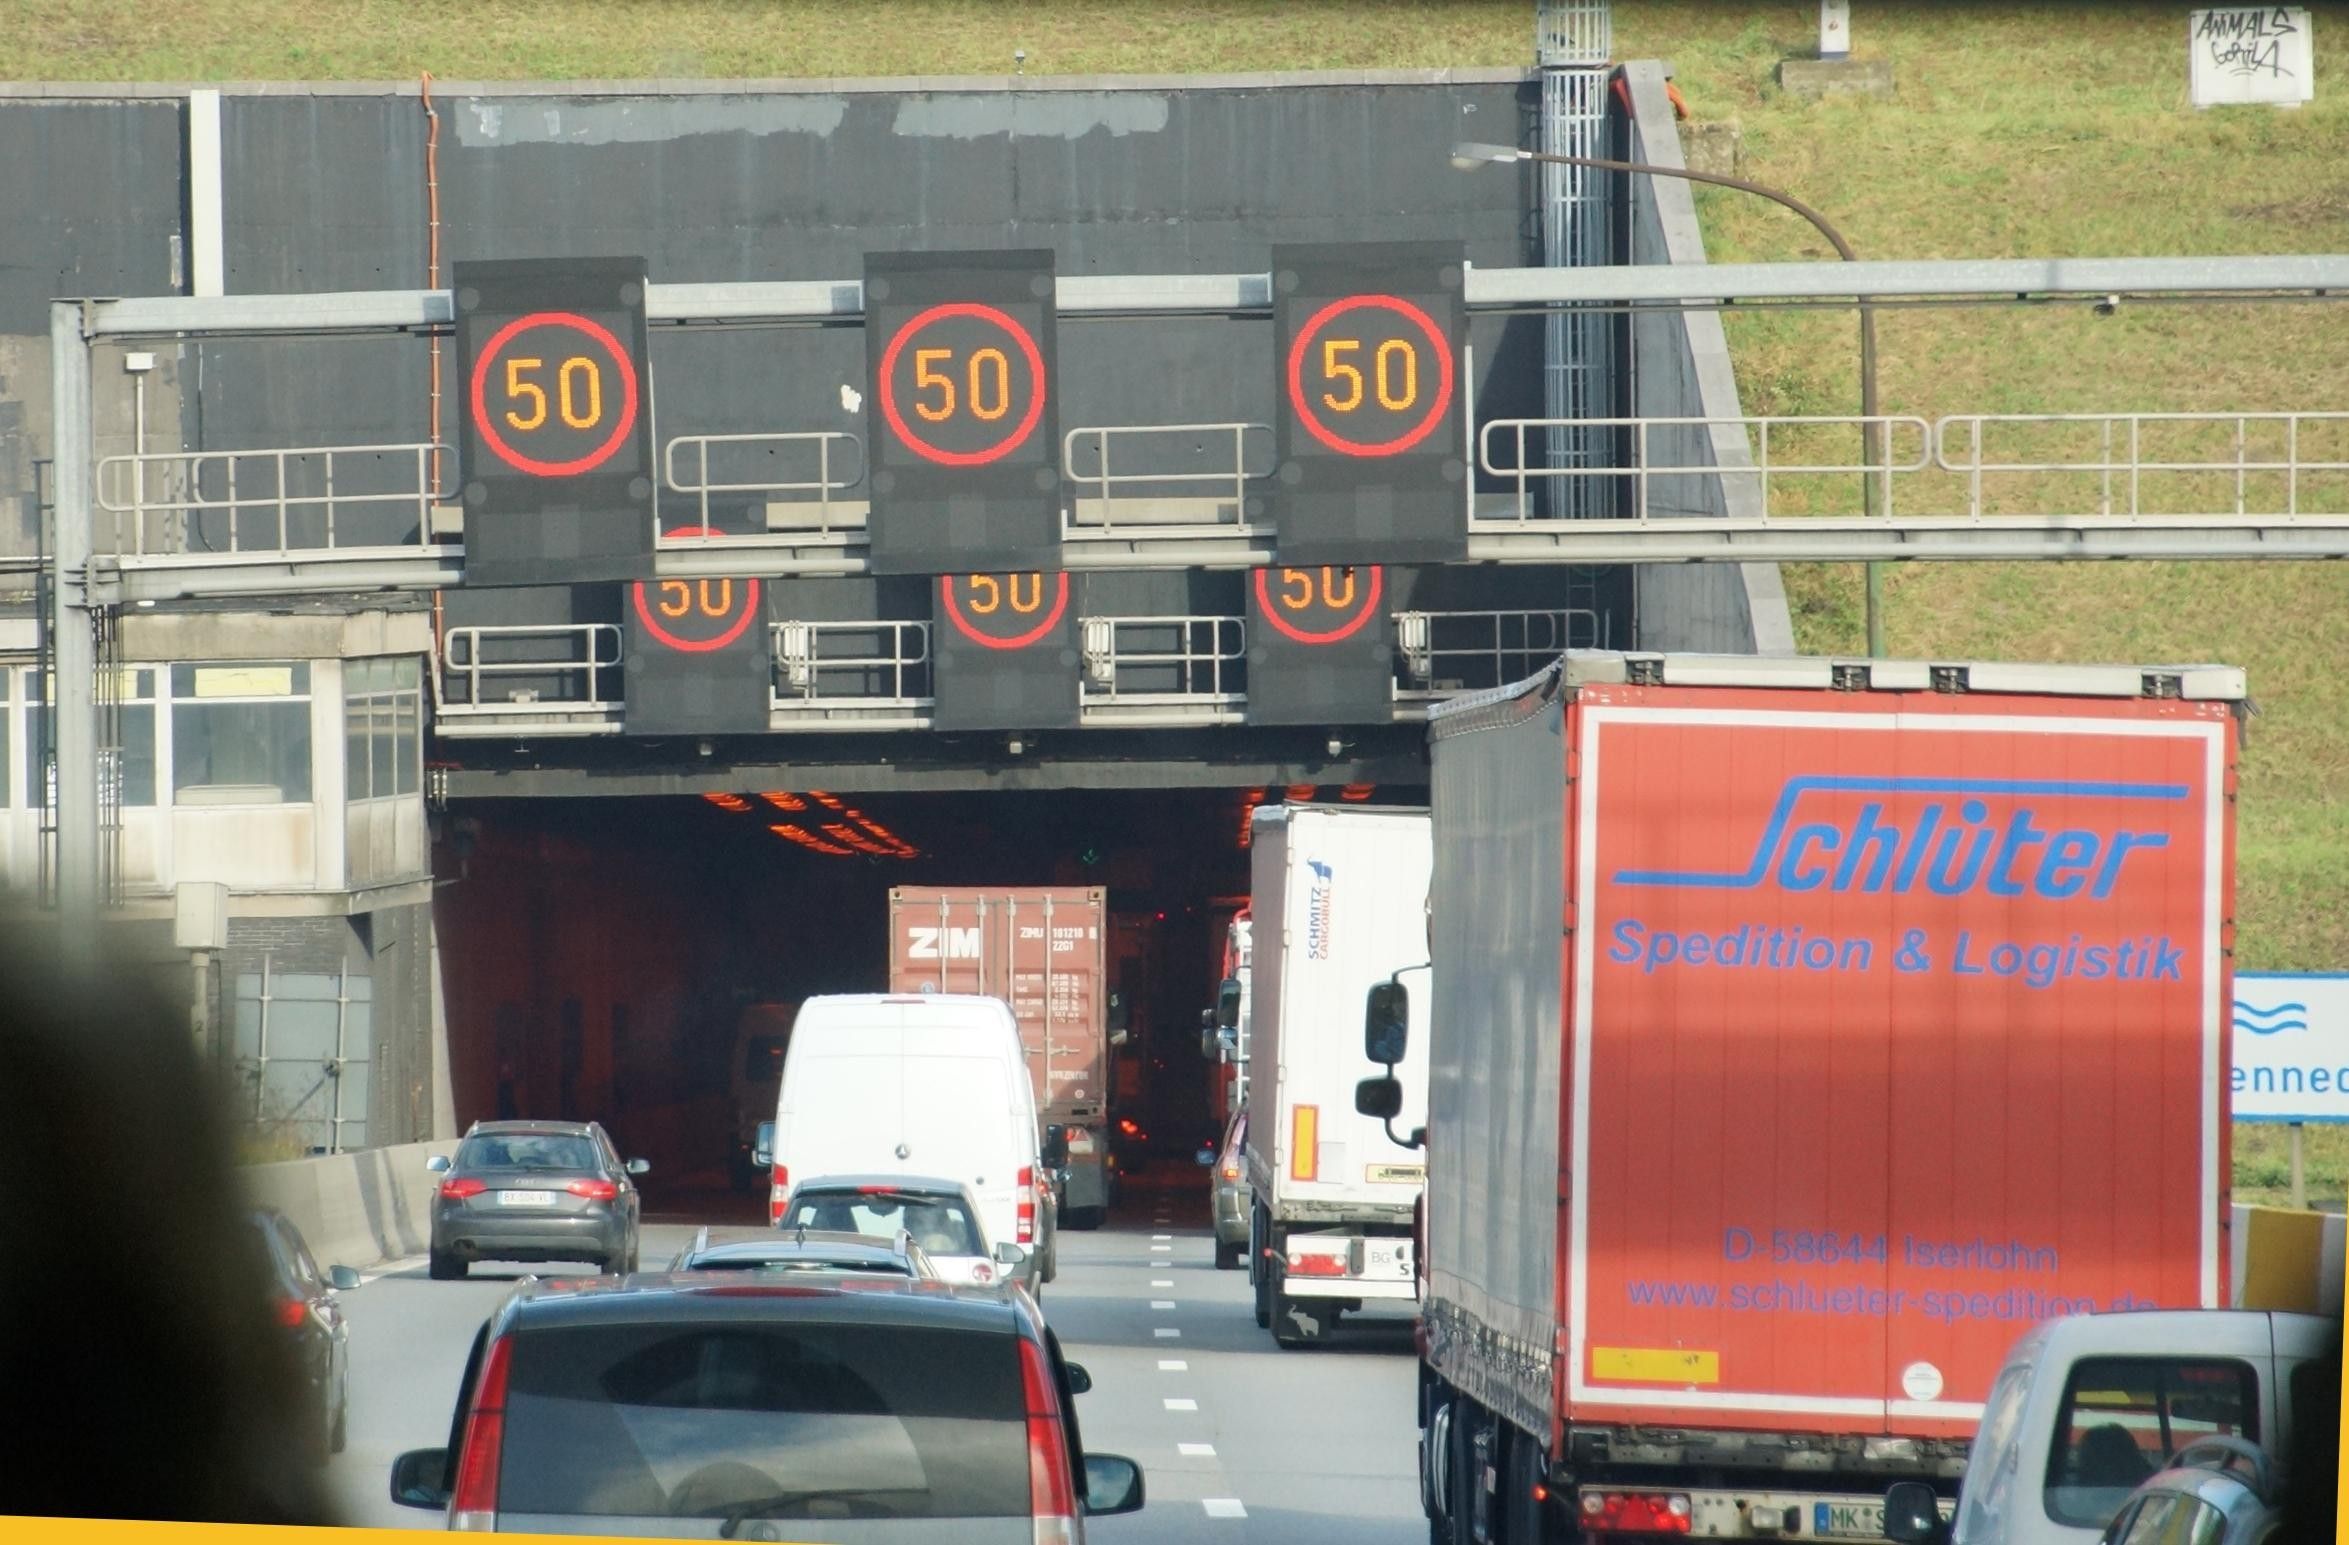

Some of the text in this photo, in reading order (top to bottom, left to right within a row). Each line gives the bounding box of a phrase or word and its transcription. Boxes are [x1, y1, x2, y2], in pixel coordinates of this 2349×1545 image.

[506, 356, 602, 430] 50
[915, 347, 1009, 421] 50
[1323, 339, 1416, 412] 50
[659, 578, 732, 617] 50
[969, 573, 1042, 613] 50
[1282, 565, 1355, 609] 50
[1610, 774, 2191, 901] Schlüter
[908, 927, 979, 958] ZIM
[1308, 887, 1321, 960] SCHMITZ
[1320, 887, 1330, 960] CARGOBULL
[1609, 918, 2185, 989] Spedition & Logistik
[1371, 1251, 1391, 1264] BG
[1724, 1227, 2057, 1272] D-58644 Iserlohn
[1628, 1279, 2158, 1321] www.schlueter-speditiond
[1831, 1507, 1857, 1529] MK
